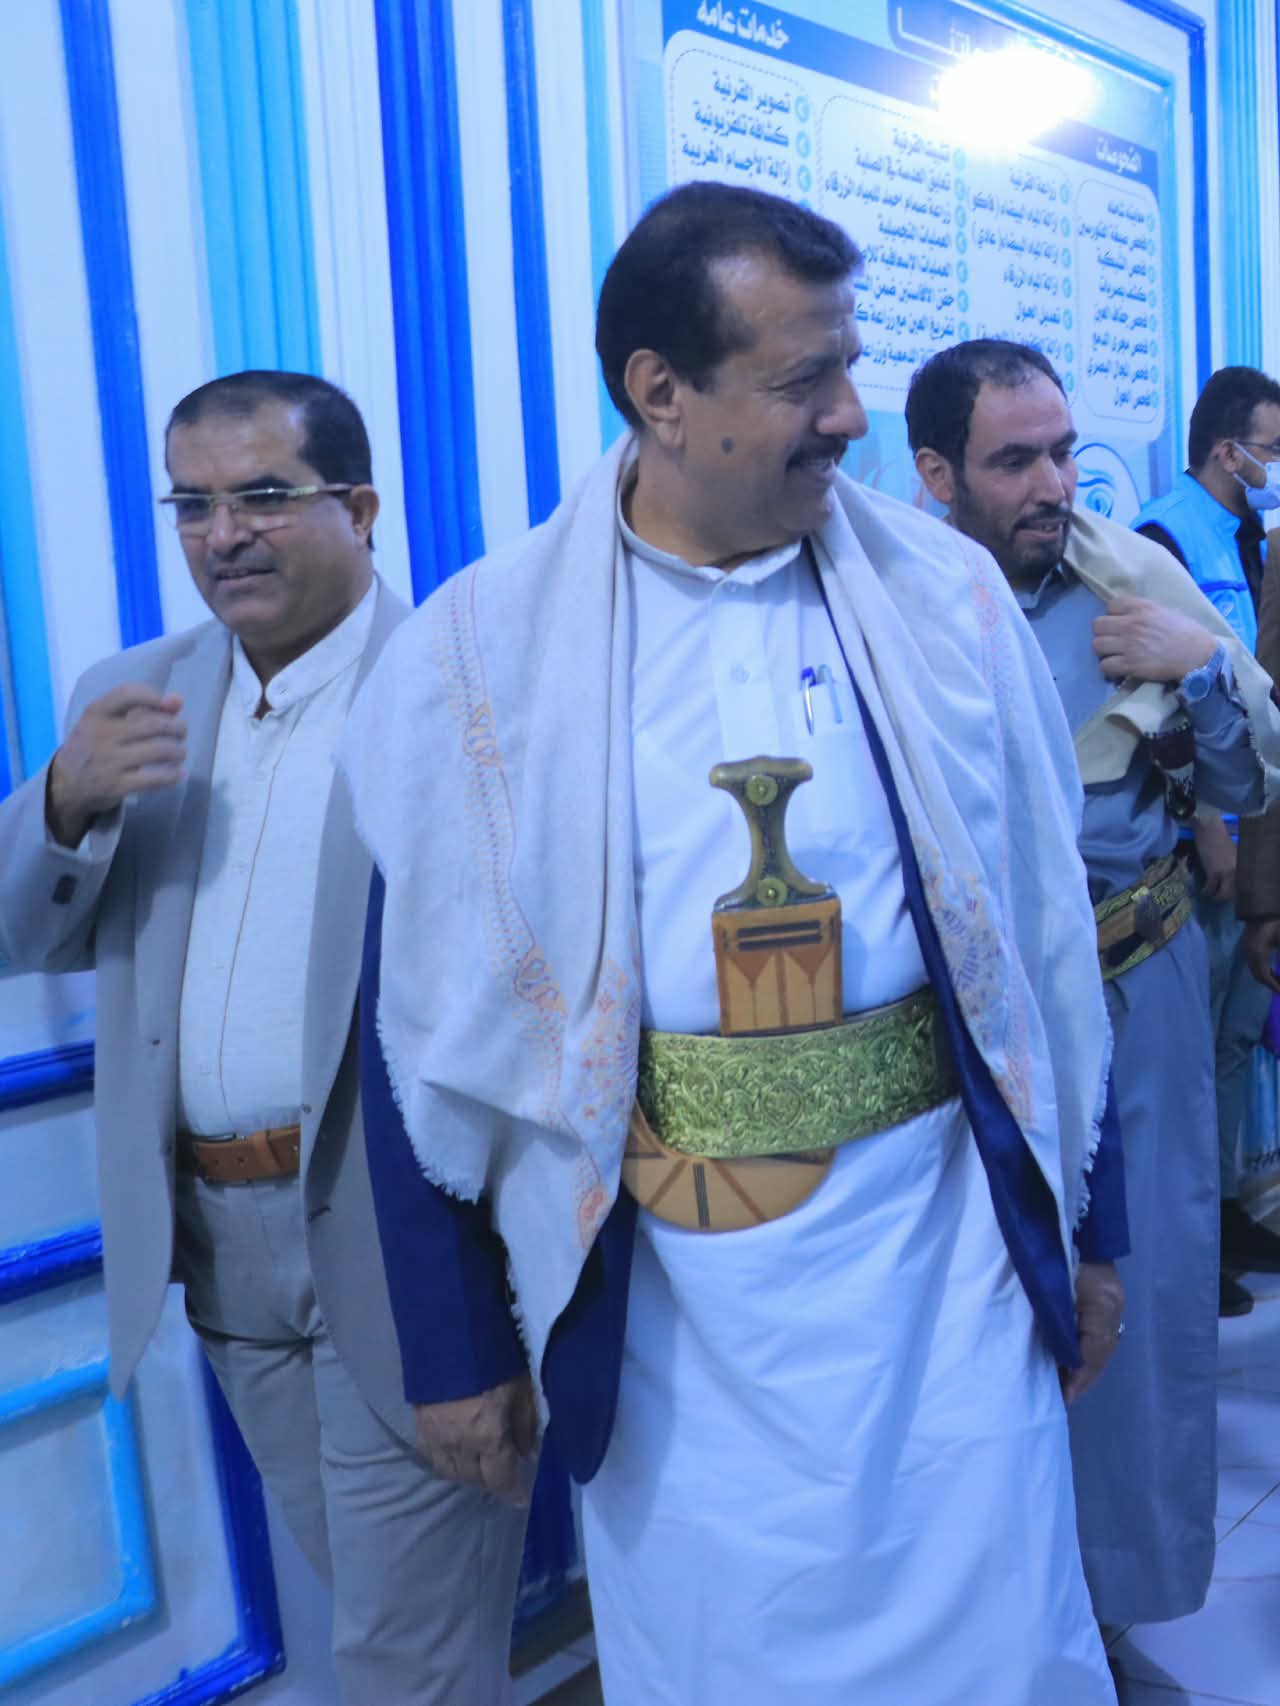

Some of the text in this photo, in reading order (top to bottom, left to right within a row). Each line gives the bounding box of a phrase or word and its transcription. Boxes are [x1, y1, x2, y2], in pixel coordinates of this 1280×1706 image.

[736, 7, 790, 49] خدمات
[712, 70, 790, 115] تصوير القرنية
[681, 133, 723, 166] الغريبة
[1096, 136, 1143, 173] الفحوصات
